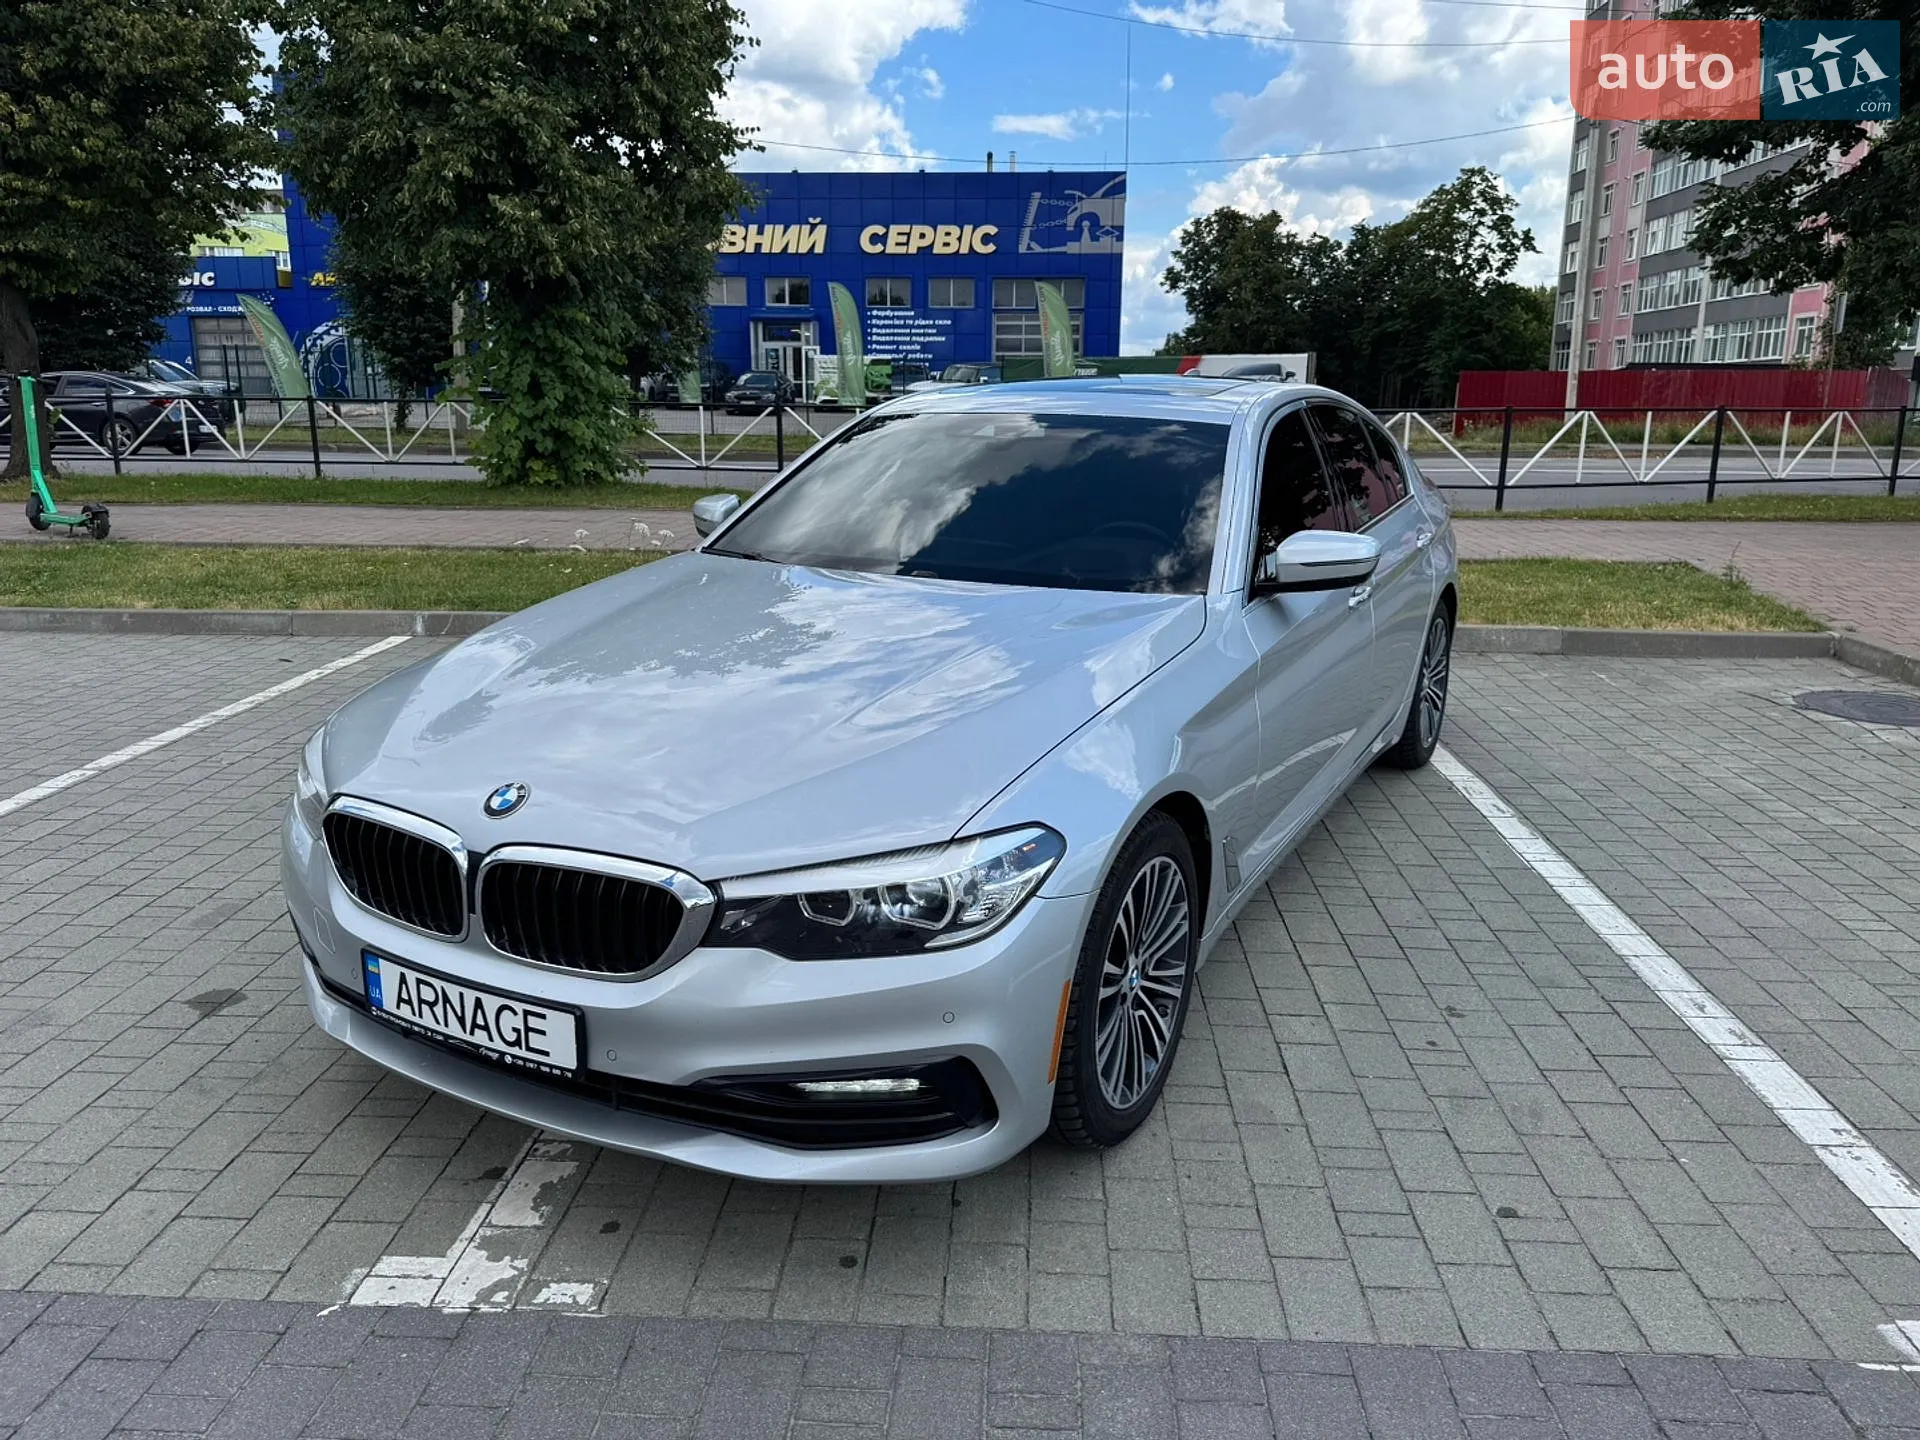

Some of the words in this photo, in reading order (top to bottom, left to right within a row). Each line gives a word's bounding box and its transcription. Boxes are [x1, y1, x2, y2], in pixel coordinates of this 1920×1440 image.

[704, 217, 828, 254] ВНИЙ
[859, 224, 999, 254] СЕРВІС
[396, 970, 551, 1058] ARNAGE
